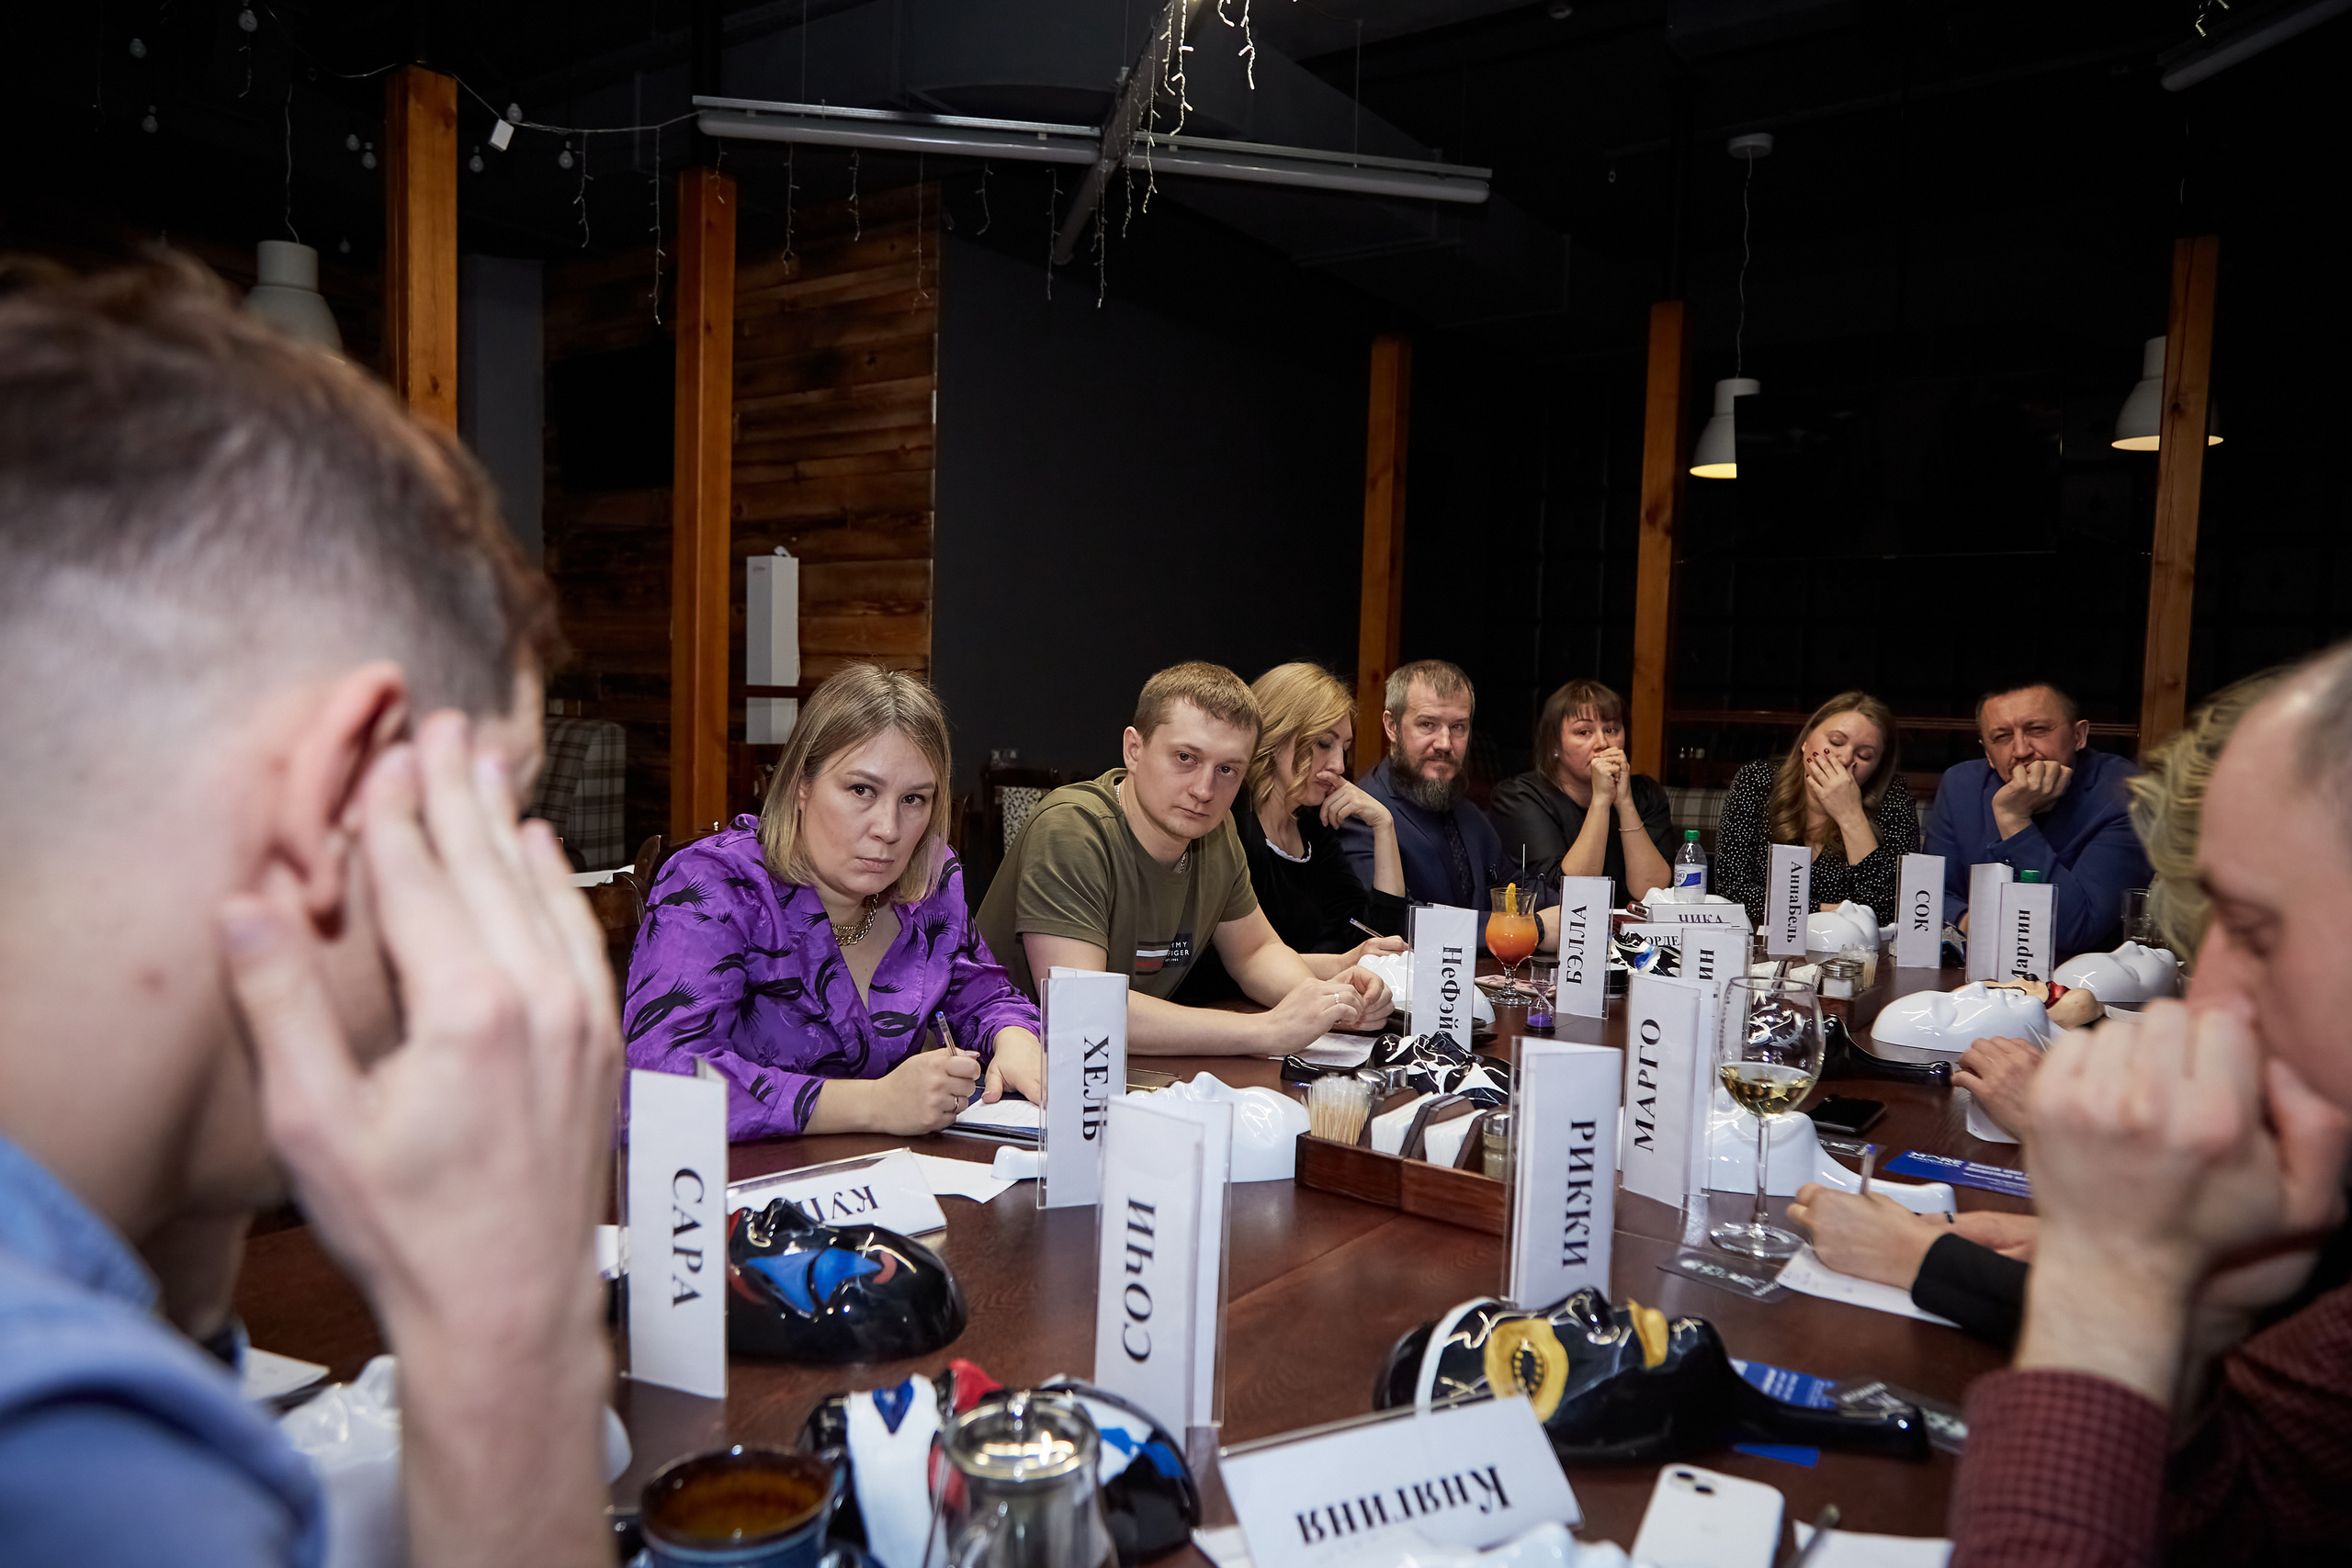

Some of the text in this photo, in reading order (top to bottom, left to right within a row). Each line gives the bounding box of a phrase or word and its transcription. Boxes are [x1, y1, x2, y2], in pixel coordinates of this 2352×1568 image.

[1645, 935, 1682, 946] ОРДЕ
[1678, 913, 1723, 923] ЧИКА
[1787, 860, 1804, 943] АннаБель
[1914, 889, 1930, 931] СОК
[1566, 905, 1587, 984] БЭЛЛА
[1700, 949, 1714, 979] ИН
[1082, 1034, 1110, 1141] ХЕЛЬ
[1634, 1018, 1661, 1153] МАРГО
[792, 1184, 880, 1224] КУП
[1562, 1118, 1598, 1270] РИККИ
[672, 1168, 705, 1309] САРА
[1122, 1195, 1157, 1363] СОЧИ
[1295, 1464, 1512, 1546] Княгиня
